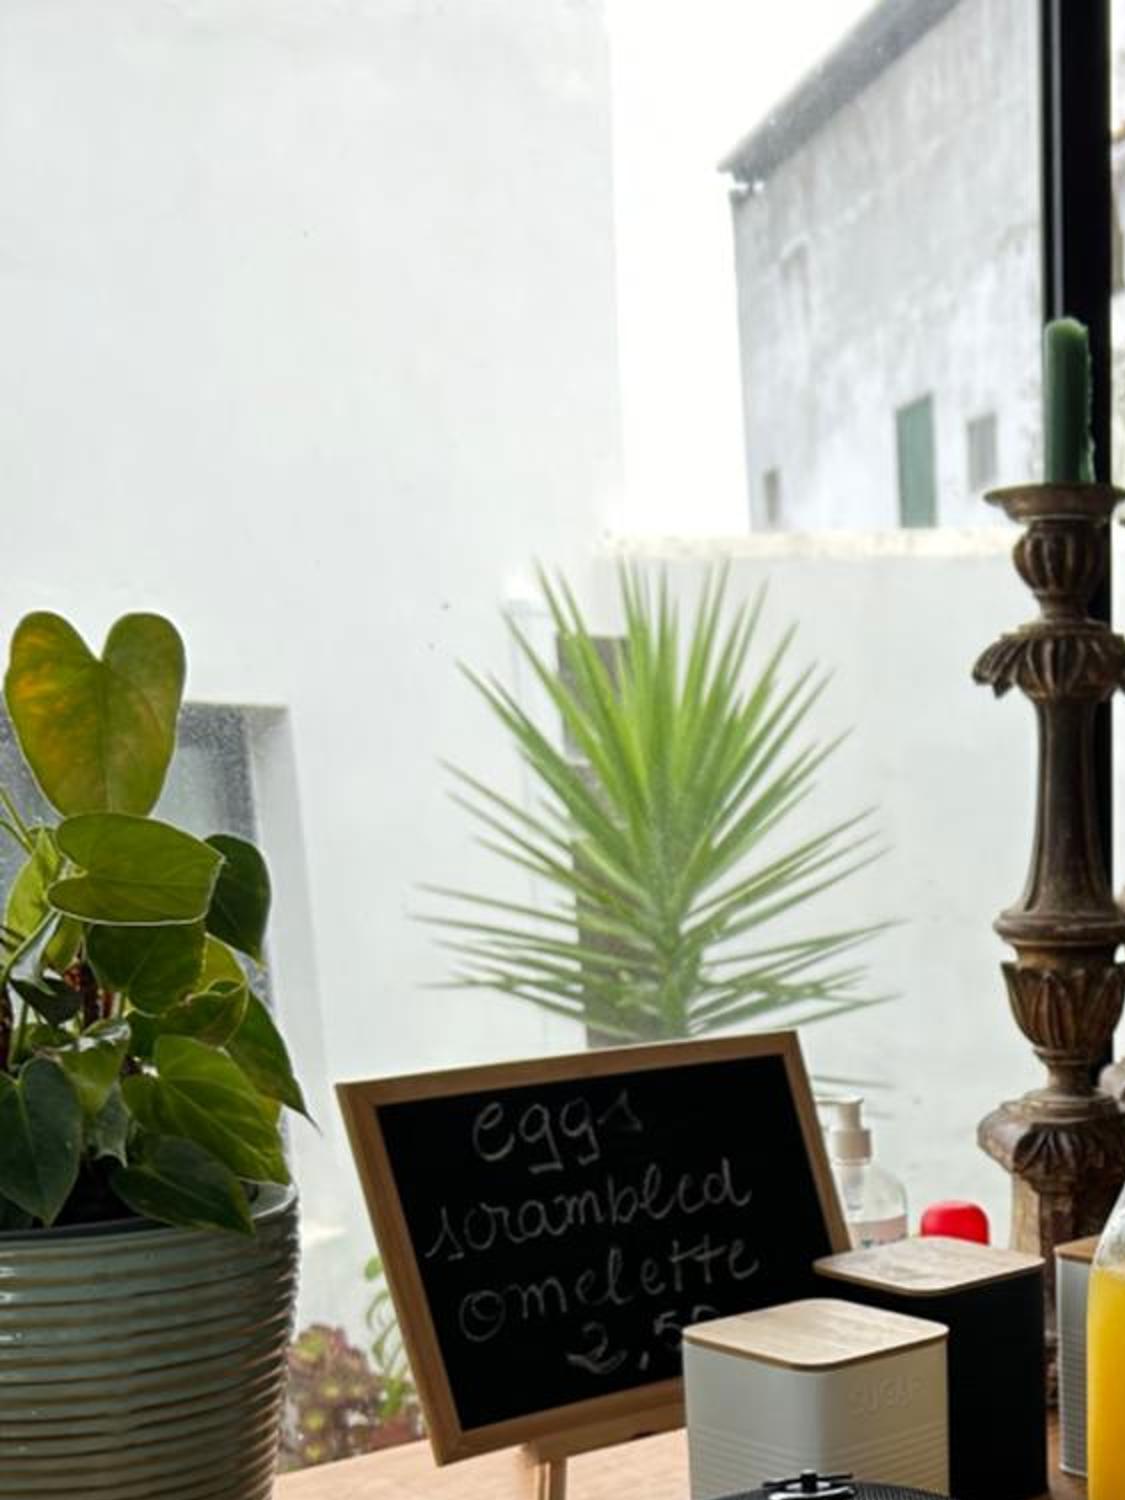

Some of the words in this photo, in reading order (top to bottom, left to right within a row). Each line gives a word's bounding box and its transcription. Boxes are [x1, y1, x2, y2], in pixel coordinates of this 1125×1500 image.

[473, 1090, 643, 1174] eggs
[424, 1157, 752, 1260] scrambled
[566, 1306, 720, 1374] 2,5
